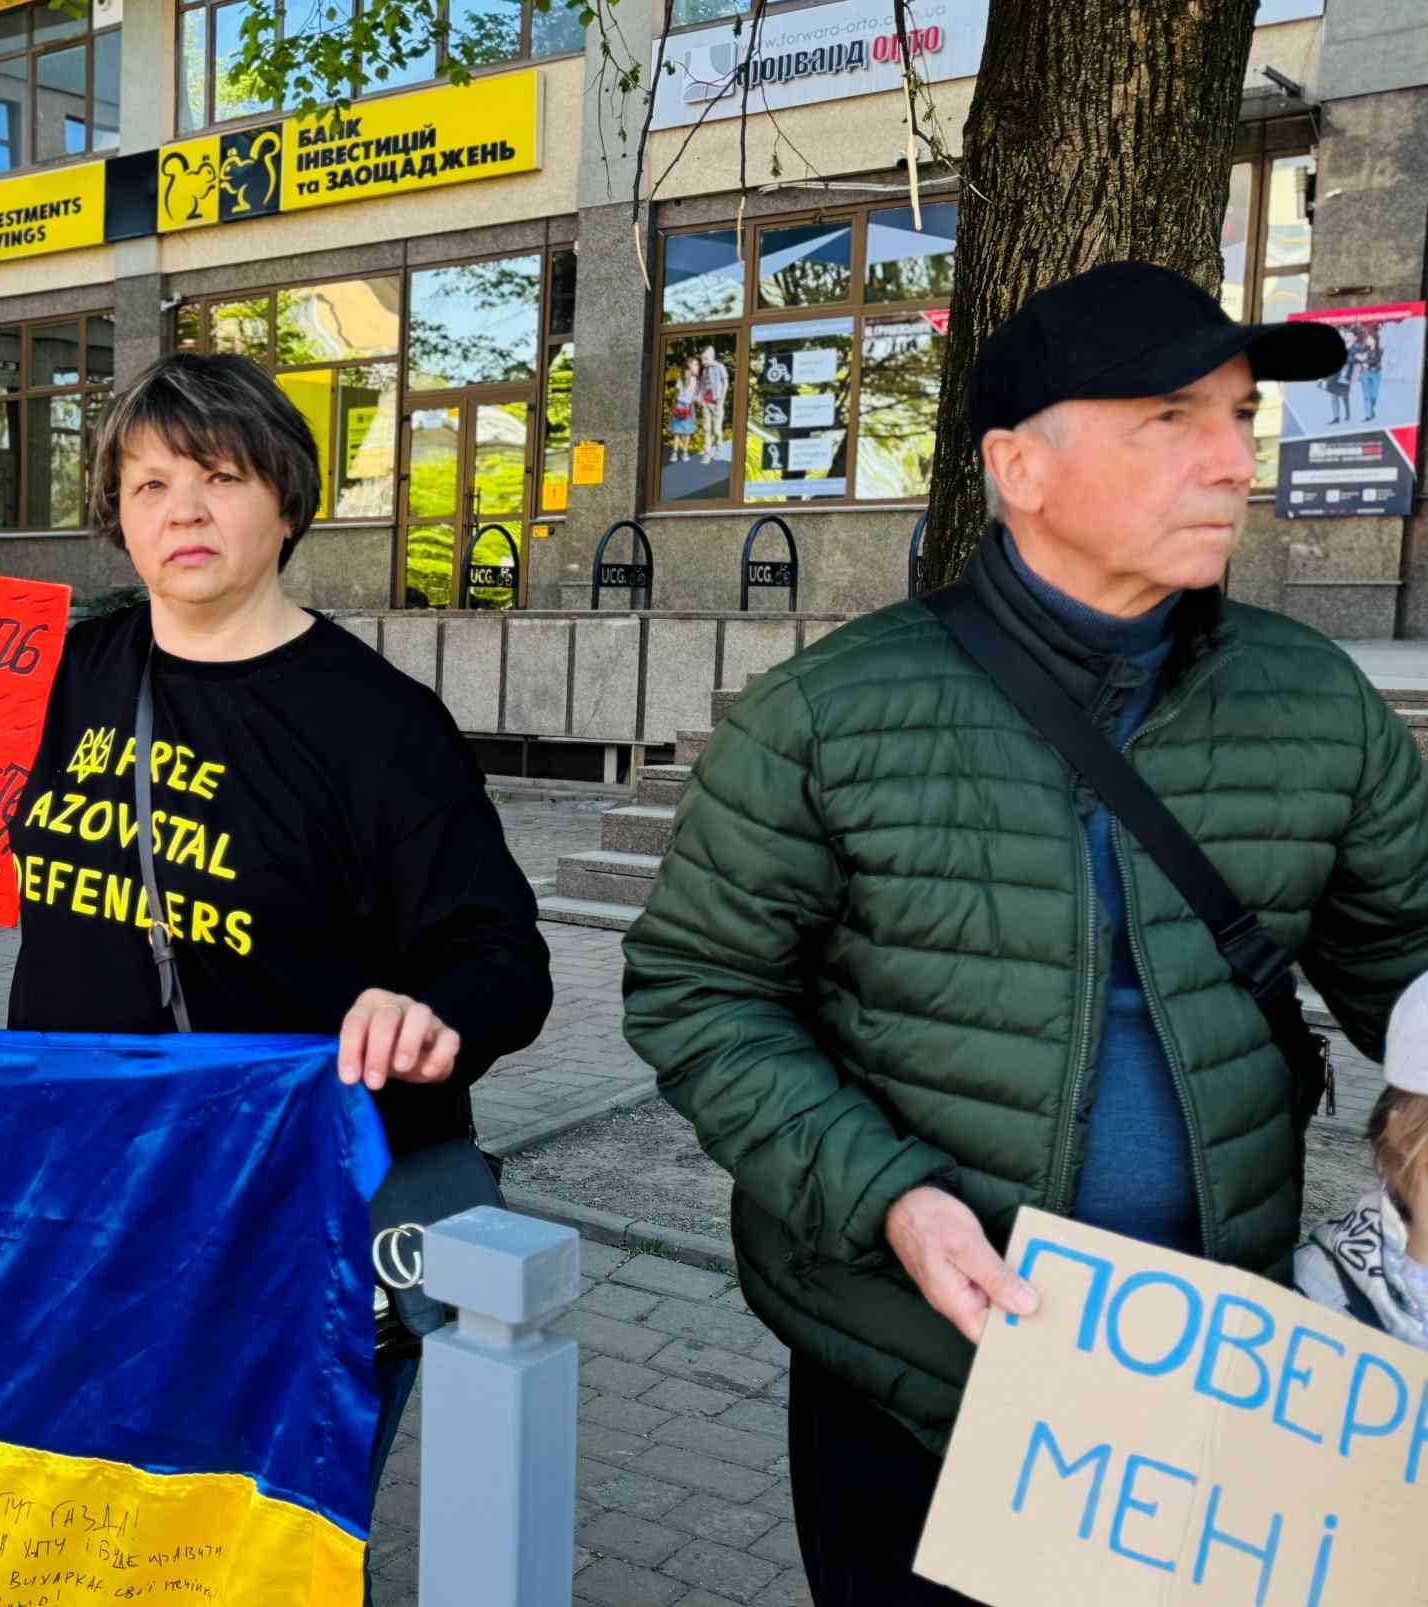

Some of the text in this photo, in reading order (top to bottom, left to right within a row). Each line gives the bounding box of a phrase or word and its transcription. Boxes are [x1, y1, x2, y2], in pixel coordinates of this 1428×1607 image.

[296, 123, 437, 172] ІНВЕСТИЦІЙ
[298, 117, 362, 148] БАНК
[297, 140, 517, 196] та ЗАОЩАДЖЕНЬ
